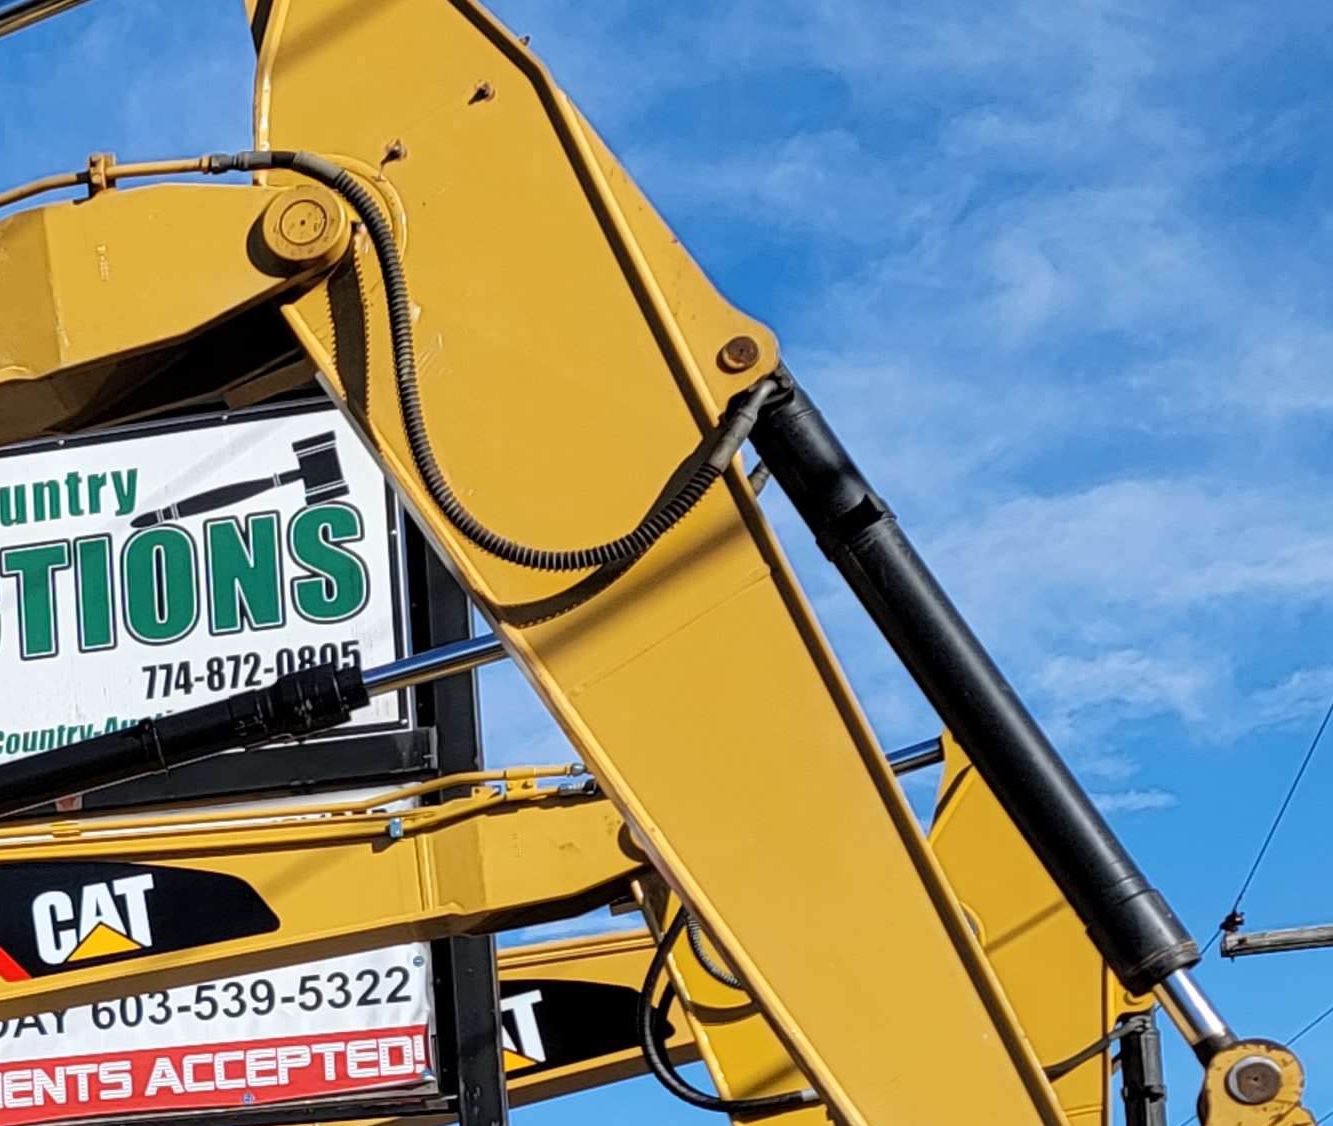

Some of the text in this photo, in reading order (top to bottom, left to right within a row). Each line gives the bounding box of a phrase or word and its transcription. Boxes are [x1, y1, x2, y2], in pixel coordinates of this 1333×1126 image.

[32, 873, 154, 965] CAT
[91, 966, 412, 1029] 603-539-5322
[144, 1034, 426, 1096] ACCEPTED!
